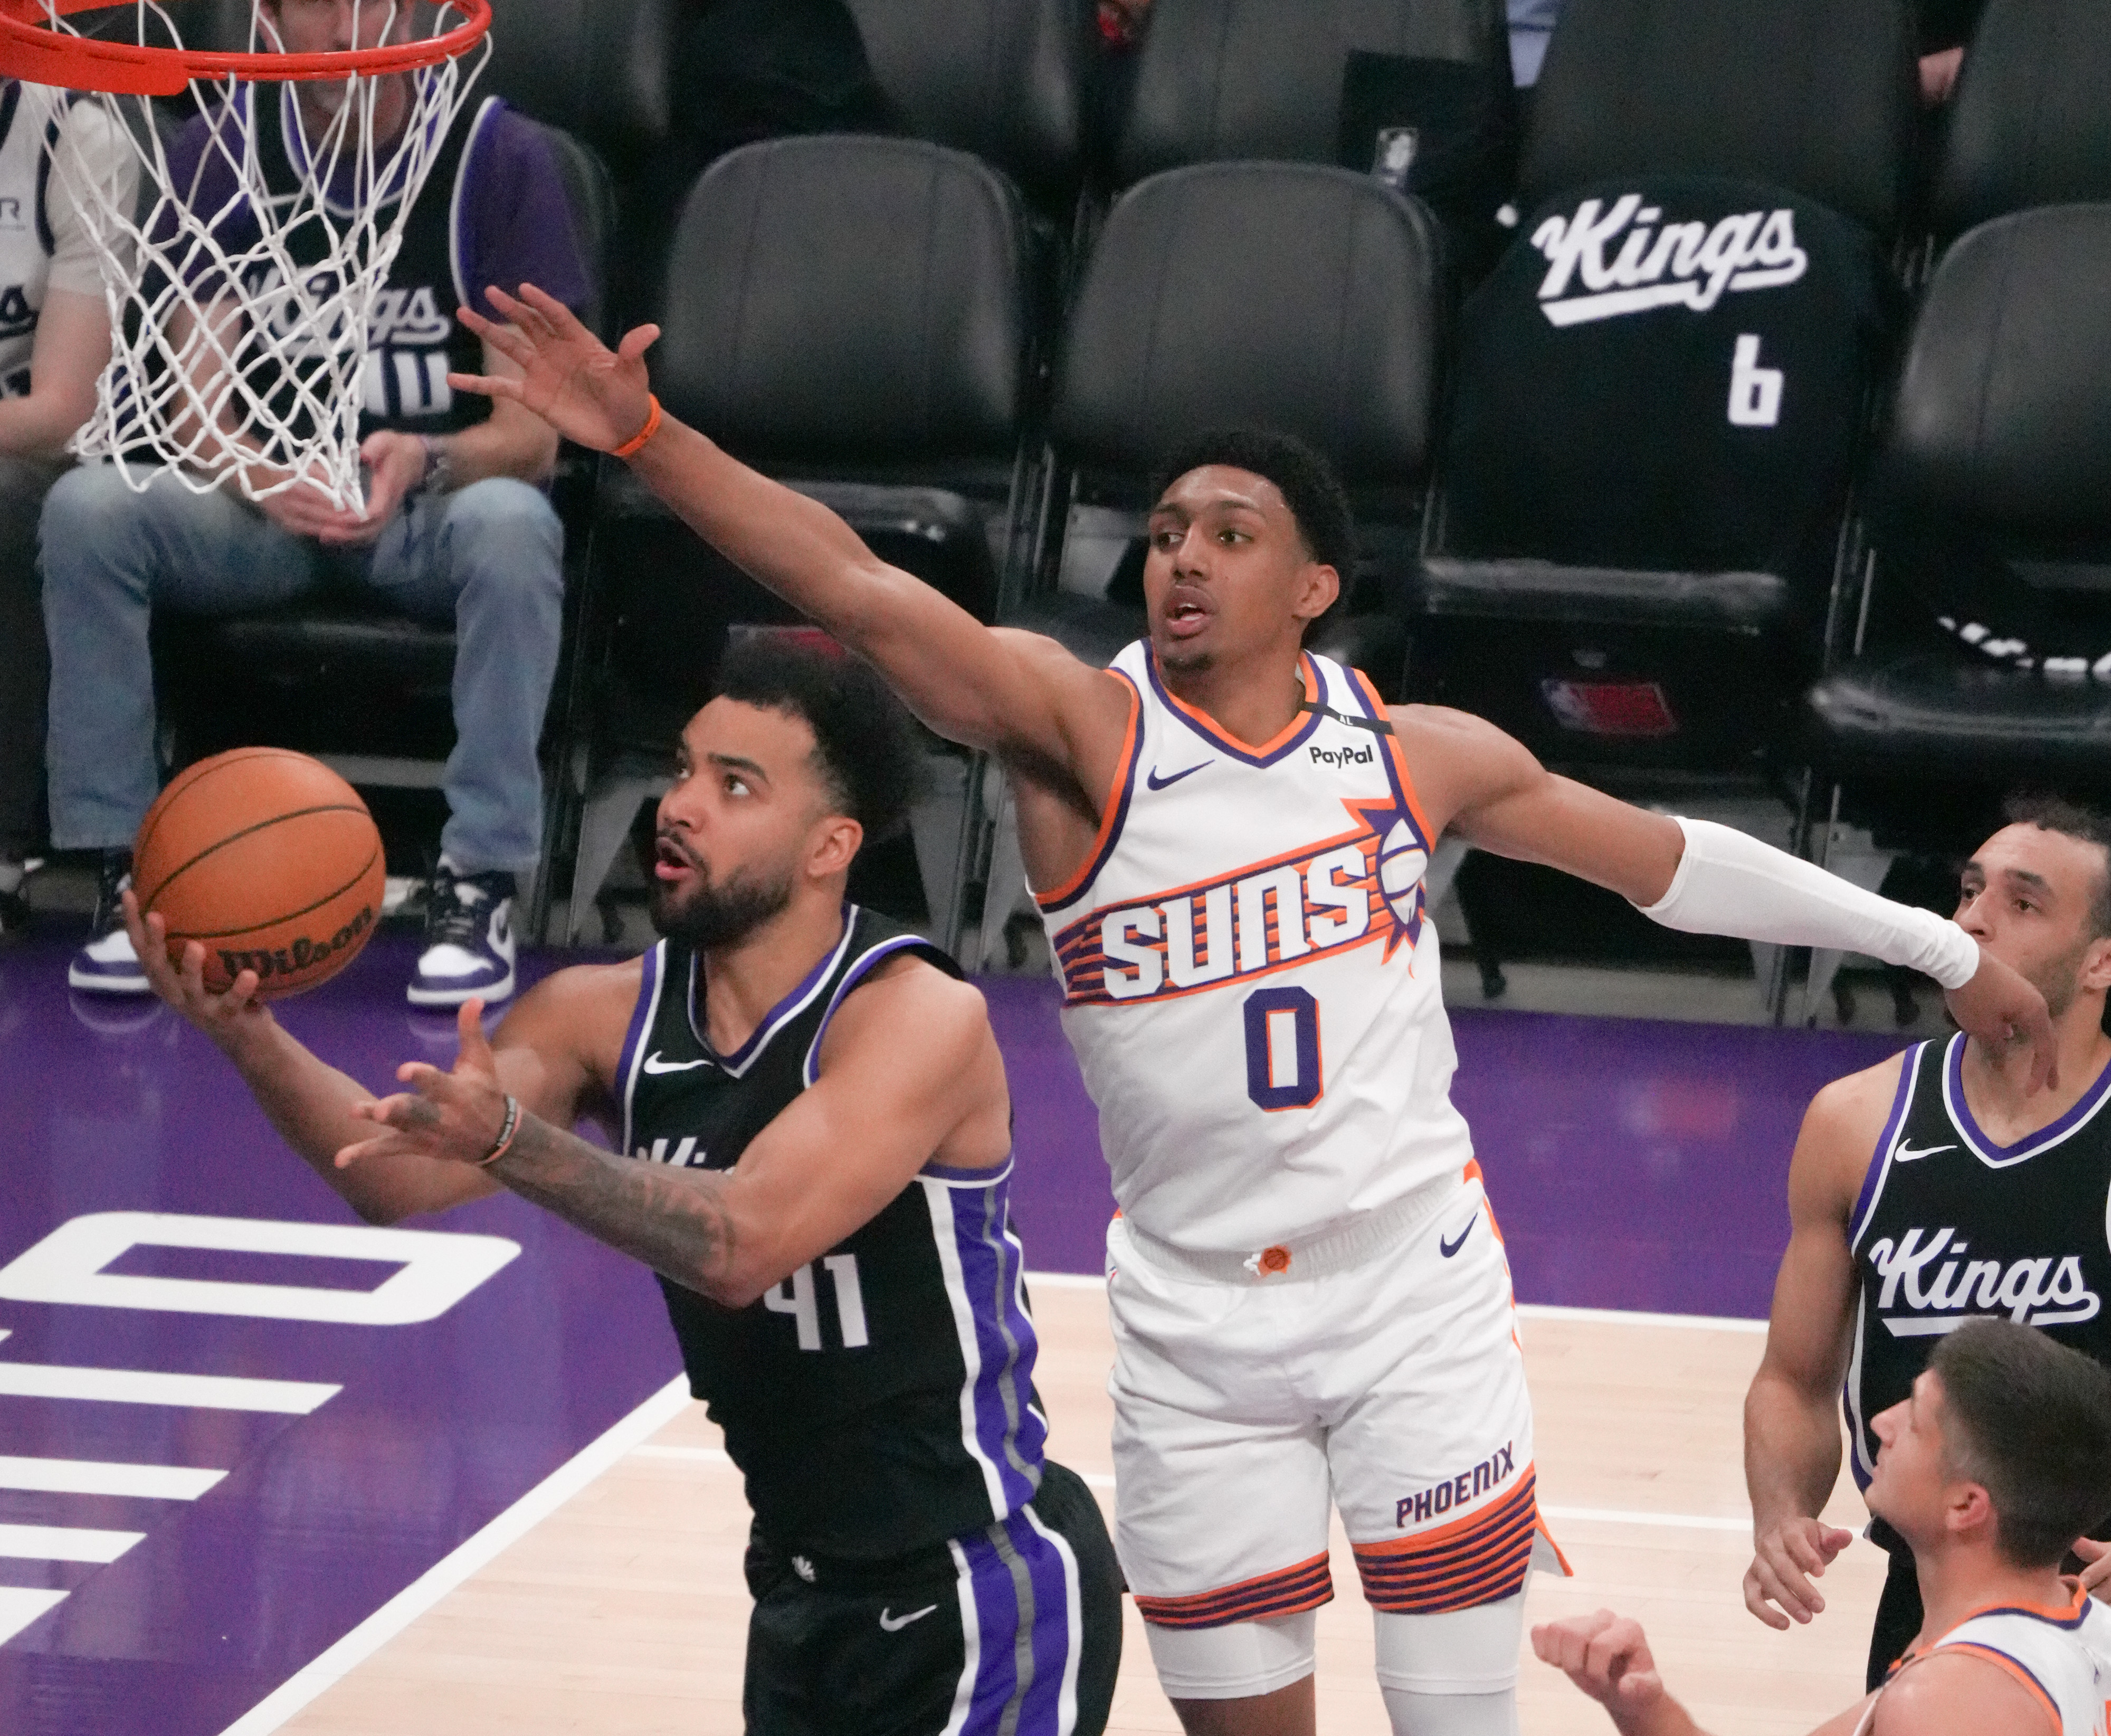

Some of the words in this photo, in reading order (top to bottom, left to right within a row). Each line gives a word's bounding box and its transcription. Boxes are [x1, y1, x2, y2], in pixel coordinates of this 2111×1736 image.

[1532, 194, 1808, 327] Kings
[1728, 333, 1783, 426] 6
[1309, 745, 1374, 769] PayPal
[216, 904, 372, 979] Wilson
[1100, 844, 1371, 999] SUNS
[1243, 986, 1324, 1112] 0
[764, 1253, 869, 1351] 41
[1868, 1228, 2100, 1337] Kings
[1395, 1439, 1515, 1529] PHOENIX
